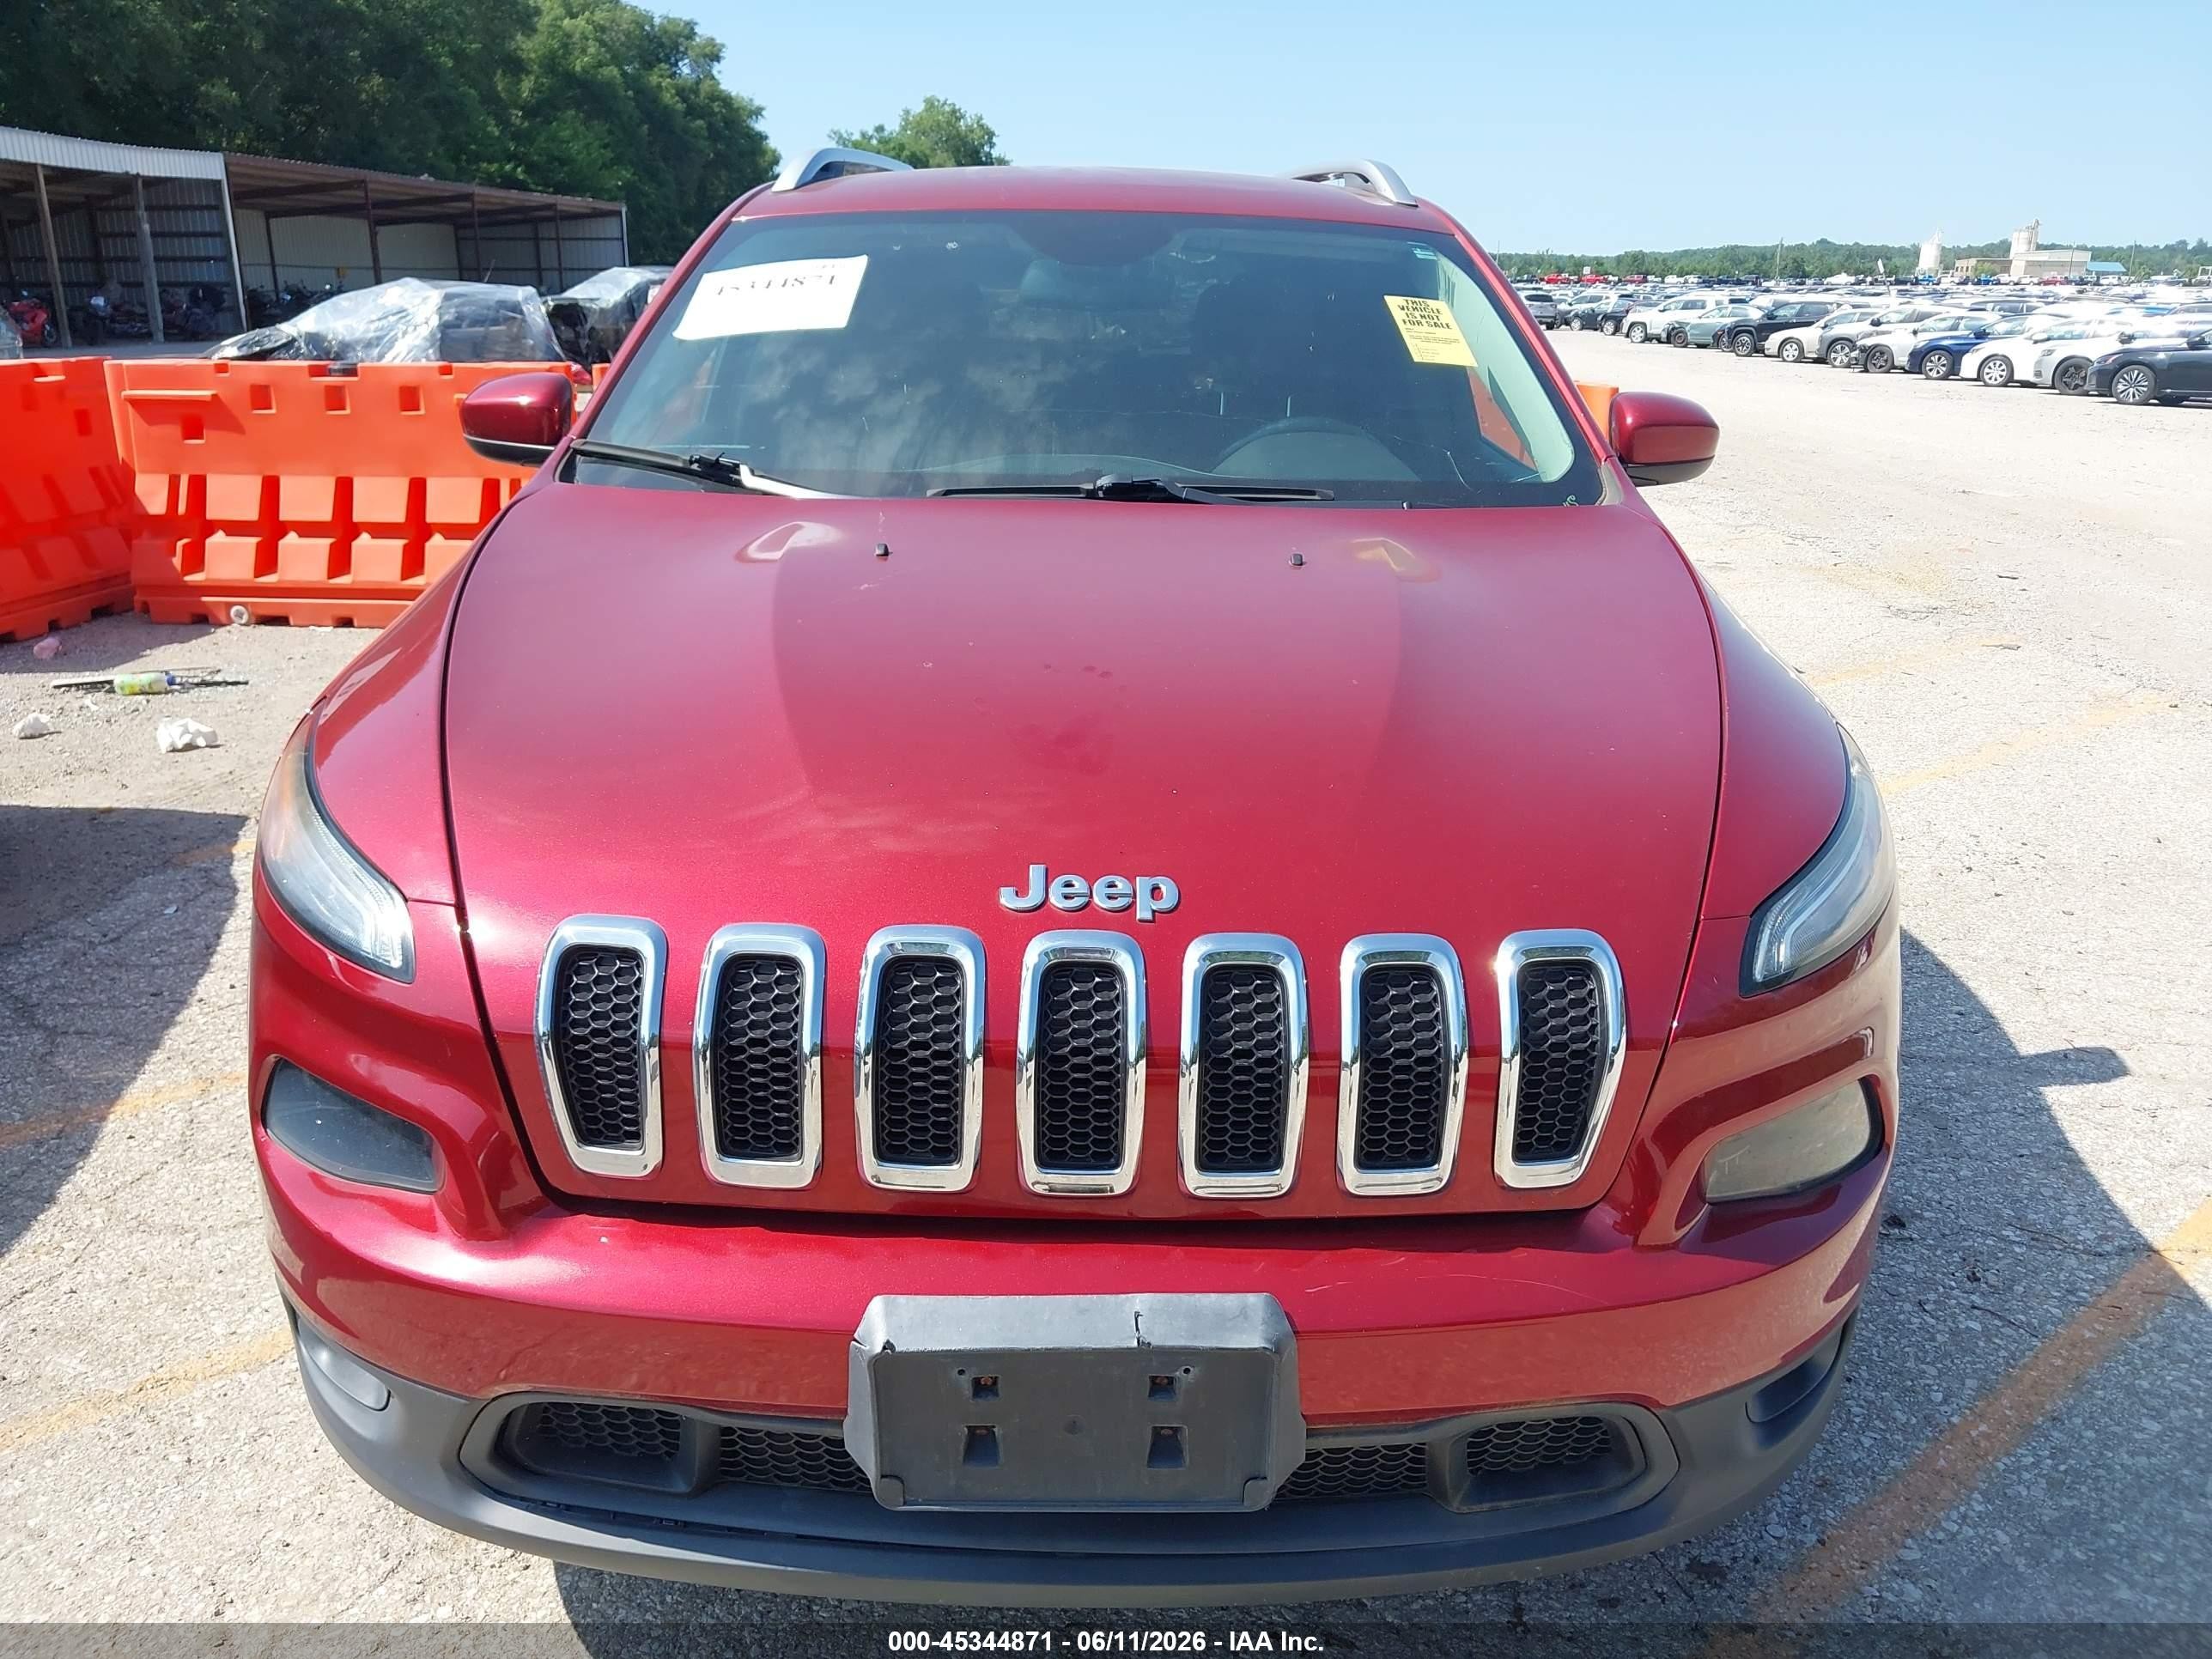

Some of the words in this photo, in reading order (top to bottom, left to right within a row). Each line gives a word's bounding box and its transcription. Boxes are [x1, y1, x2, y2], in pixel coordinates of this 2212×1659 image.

[1398, 305, 1443, 315] VEHICLE
[1426, 321, 1452, 330] SALE
[999, 864, 1180, 923] Jeep
